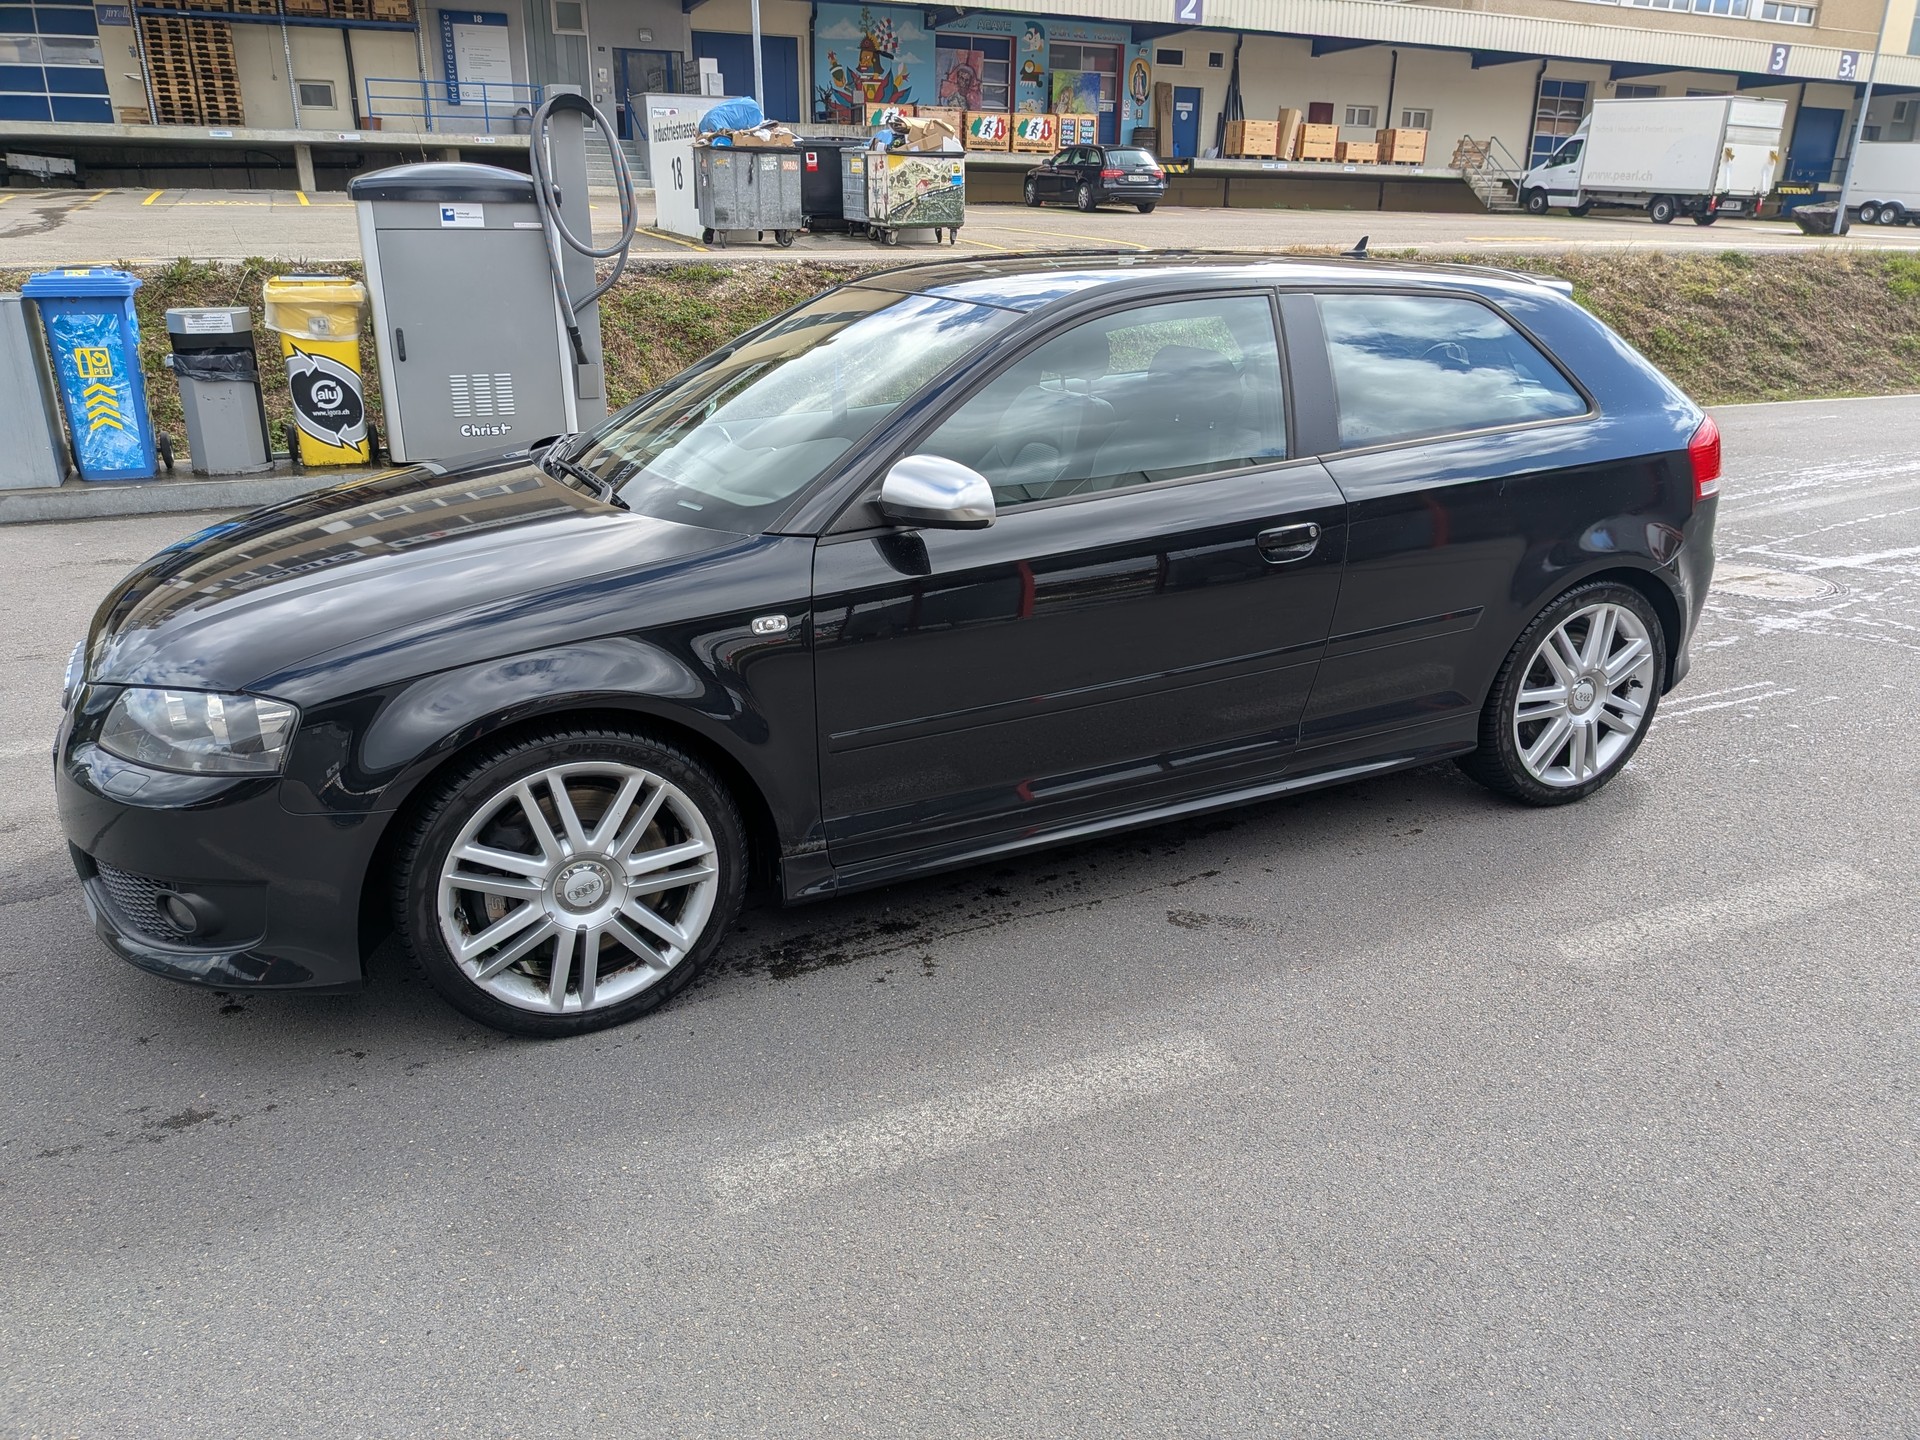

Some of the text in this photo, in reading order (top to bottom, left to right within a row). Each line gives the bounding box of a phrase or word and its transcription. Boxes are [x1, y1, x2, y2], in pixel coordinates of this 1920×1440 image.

[1180, 0, 1196, 19] 2
[473, 14, 483, 23] 18
[1772, 48, 1786, 70] 3
[1839, 54, 1856, 77] 3.1
[653, 120, 696, 143] Industriestrasse
[671, 156, 684, 191] 18
[1587, 170, 1653, 183] www.pearl.ch
[94, 367, 109, 375] PET
[317, 388, 337, 400] alu
[312, 409, 350, 417] www.igora.ch
[460, 422, 512, 437] Christ
